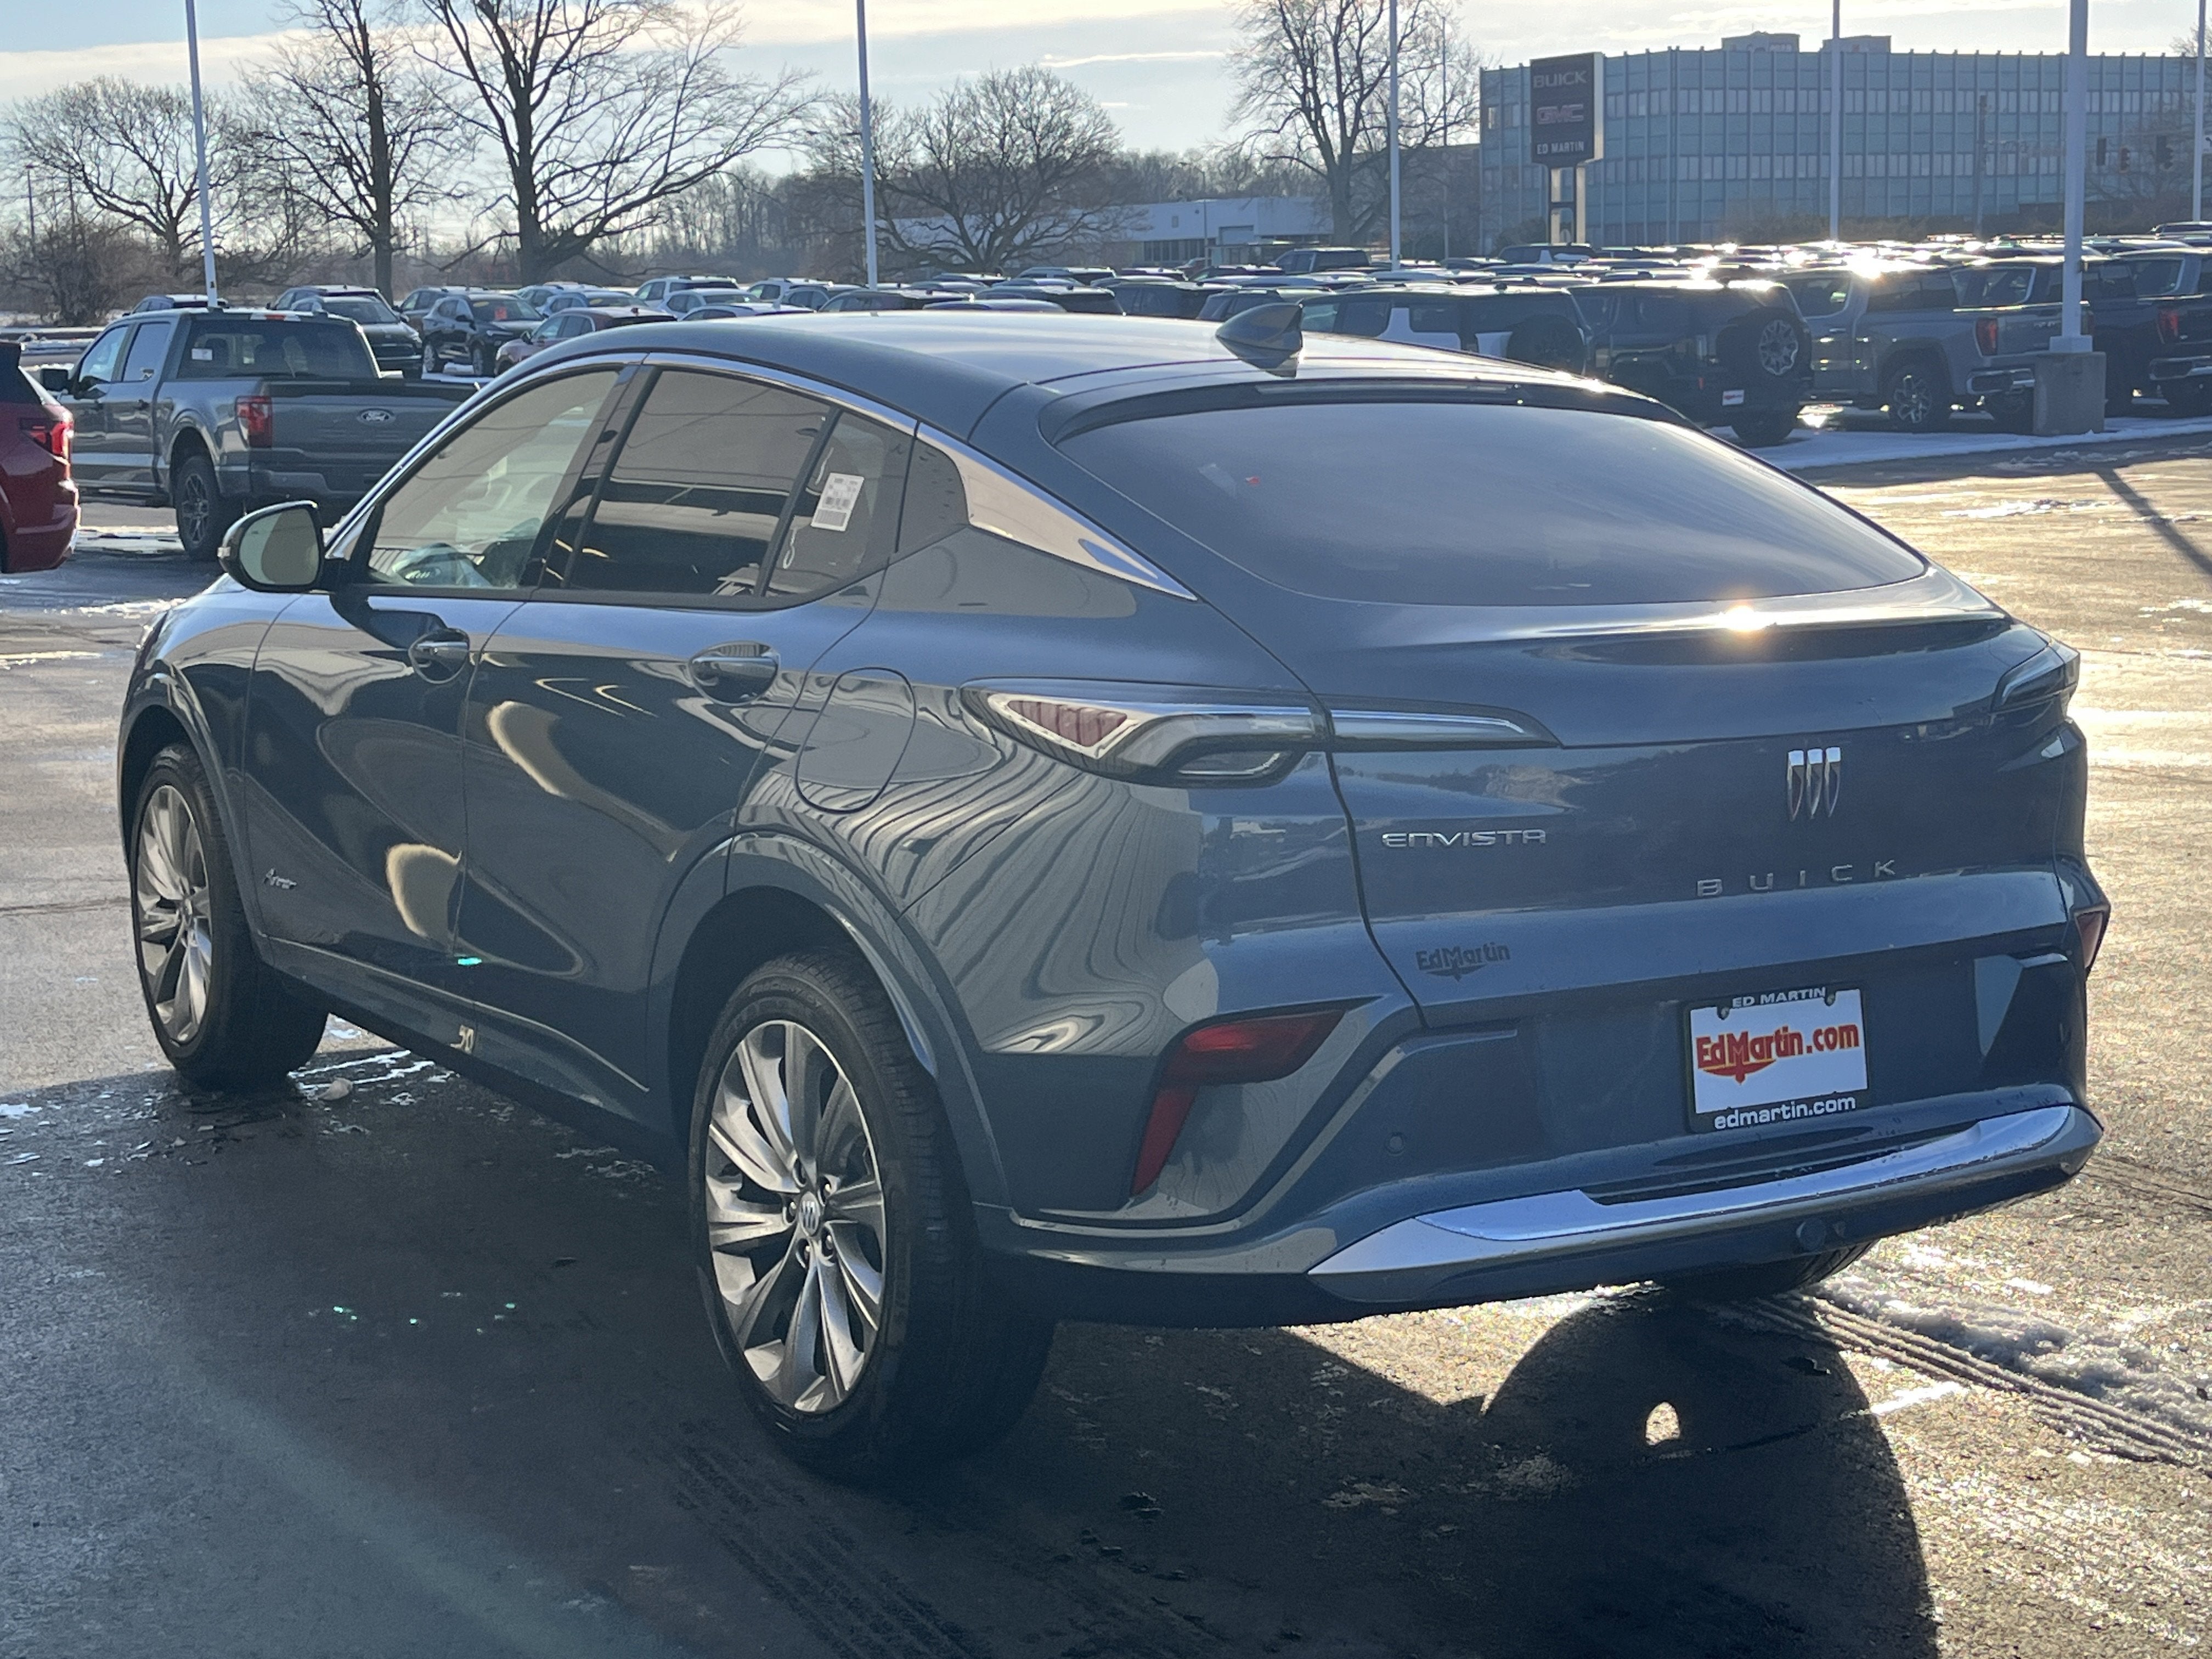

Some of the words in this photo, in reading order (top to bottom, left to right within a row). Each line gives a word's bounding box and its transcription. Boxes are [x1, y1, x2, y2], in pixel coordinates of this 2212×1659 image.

[1533, 71, 1587, 88] BUICK
[1537, 104, 1584, 125] GMC
[1537, 143, 1548, 155] ED
[1551, 141, 1584, 154] MARTIN
[1382, 829, 1546, 848] ENVISTA
[1697, 860, 1895, 897] BUICK
[1415, 941, 1510, 970] EdMartin
[1732, 996, 1754, 1008] ED
[1760, 987, 1826, 1005] MARTIN
[1696, 1025, 1859, 1070] EdMartin.com
[1714, 1096, 1857, 1130] edmartin.com
